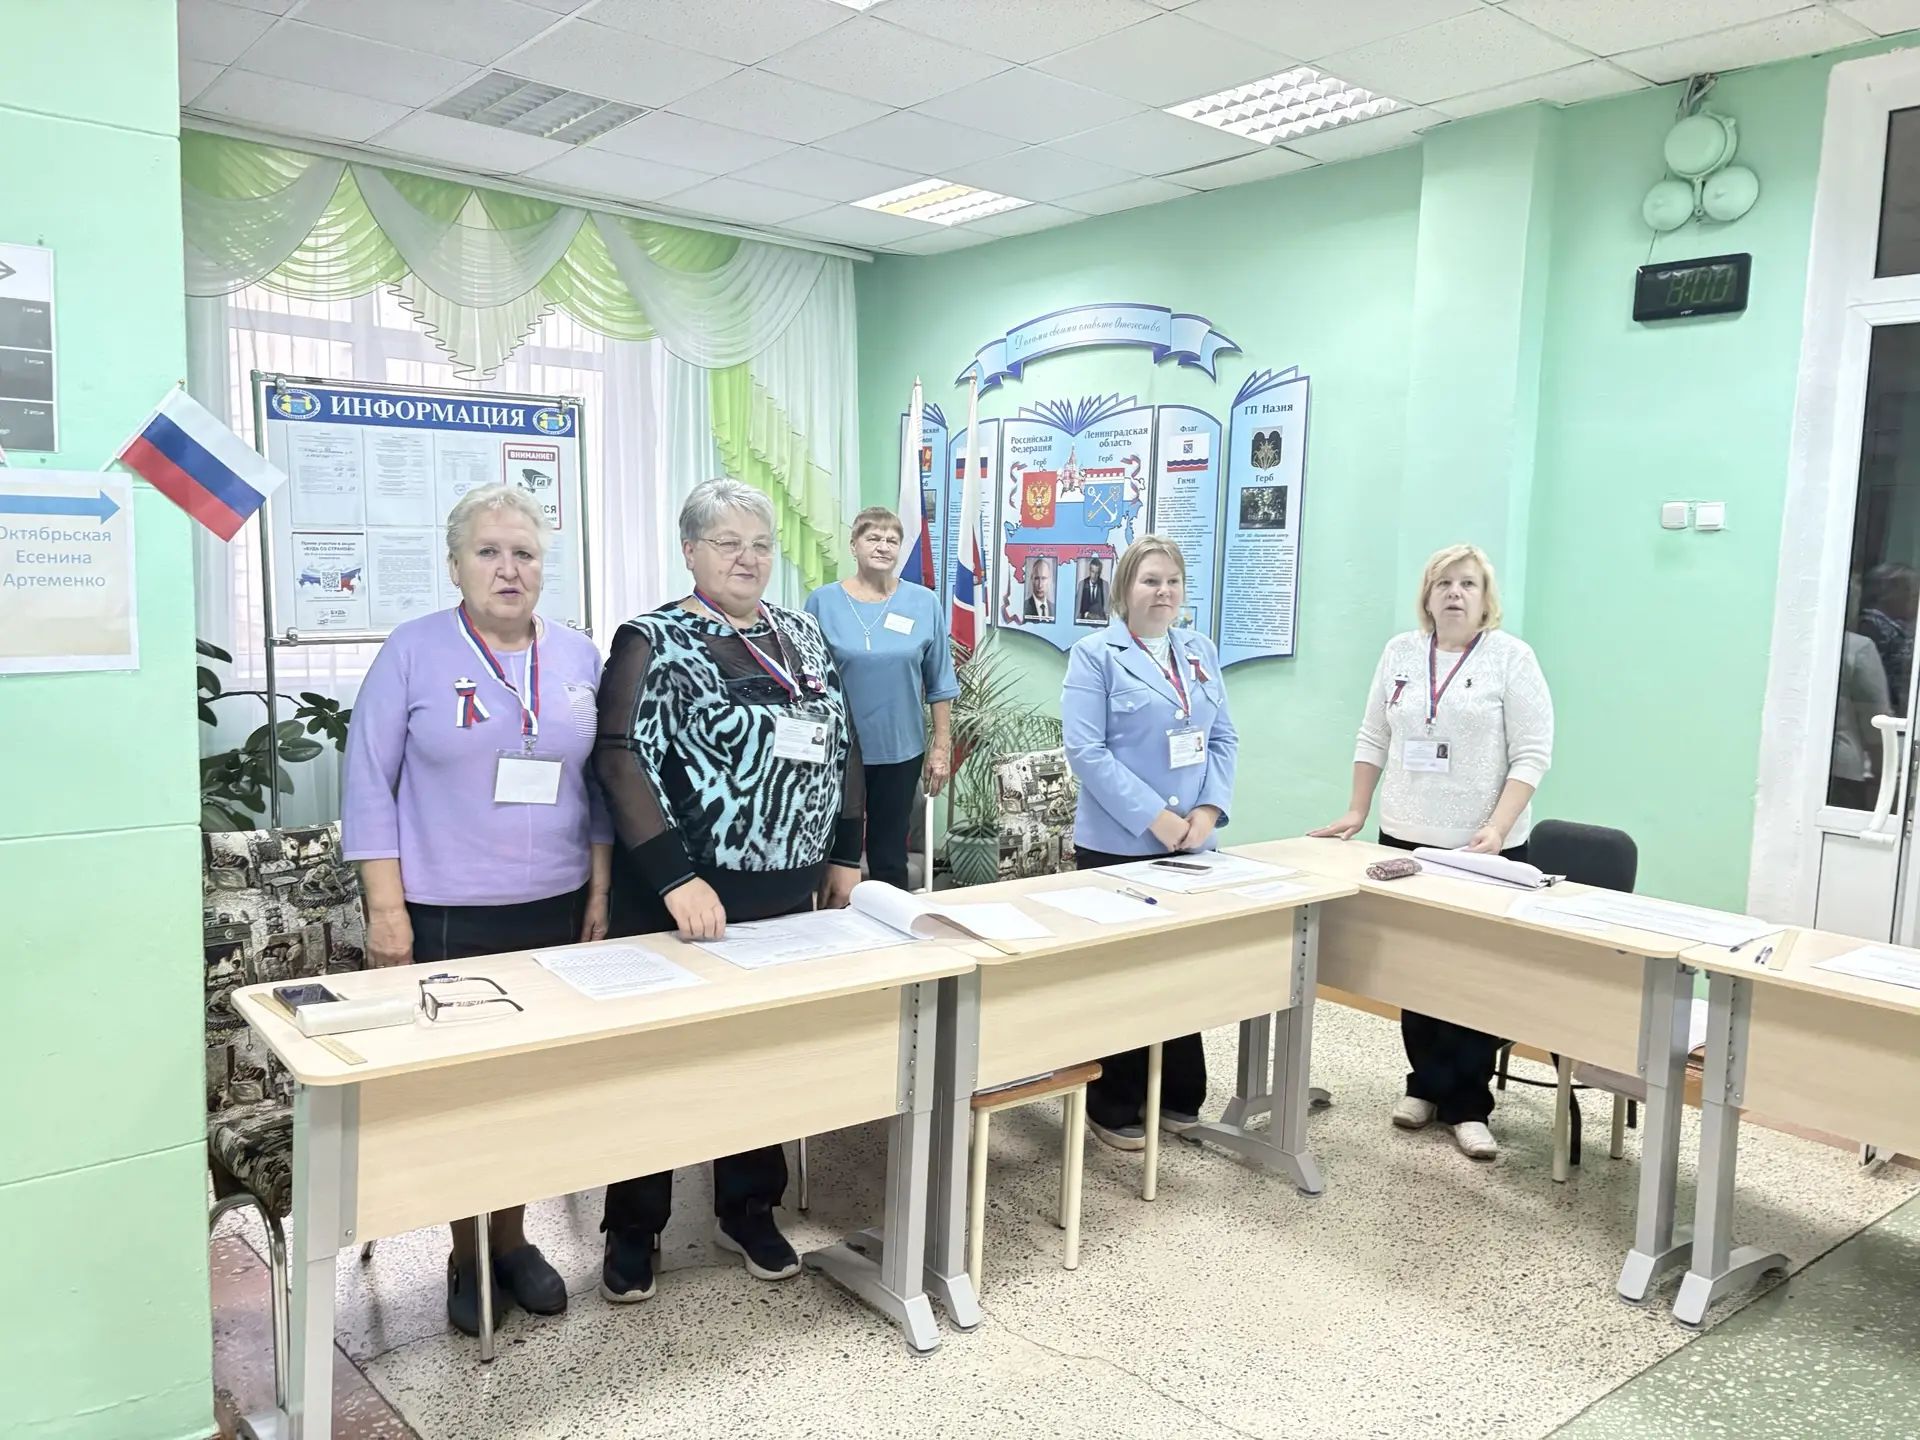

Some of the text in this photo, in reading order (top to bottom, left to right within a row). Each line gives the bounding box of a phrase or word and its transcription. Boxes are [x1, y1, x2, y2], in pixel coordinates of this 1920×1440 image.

[1114, 316, 1161, 332] Отечество
[330, 395, 526, 429] ИНФОРМАЦИЯ
[1244, 404, 1294, 415] ГП Назия
[1085, 427, 1149, 440] Ленинградская
[1180, 425, 1198, 433] Флаг
[1010, 435, 1053, 445] Российская
[1099, 438, 1132, 448] область
[1010, 444, 1052, 454] Федерация
[510, 451, 553, 460] ВНИМАНИЕ!
[1098, 455, 1114, 463] Герб
[1033, 458, 1048, 466] Герб
[1255, 473, 1274, 483] Герб
[16, 550, 92, 564] Есенина
[3, 572, 106, 590] Артеменко
